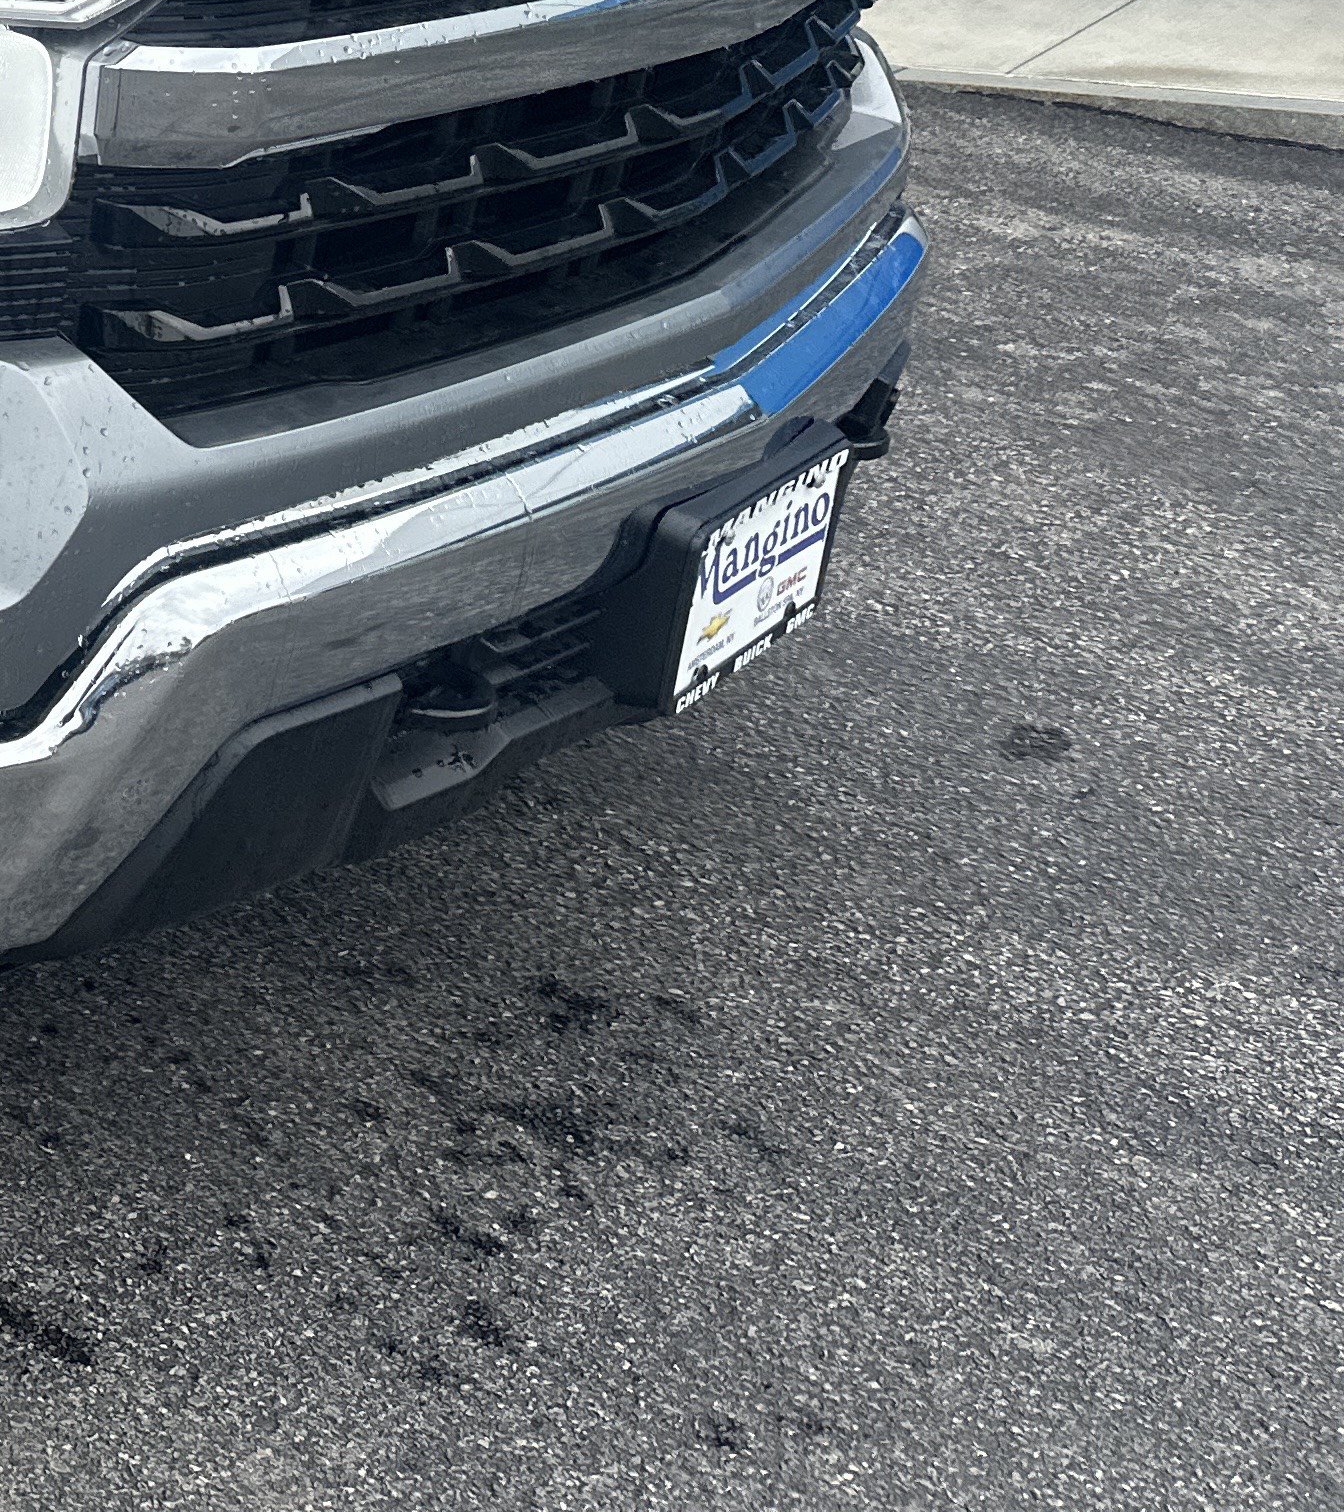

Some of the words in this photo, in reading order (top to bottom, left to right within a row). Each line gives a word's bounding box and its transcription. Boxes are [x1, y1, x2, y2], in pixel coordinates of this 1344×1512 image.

[699, 491, 830, 604] Mangino
[776, 566, 808, 596] GMC
[675, 672, 720, 714] CHEVY
[733, 633, 773, 673] BUICK
[785, 603, 815, 634] GMC
